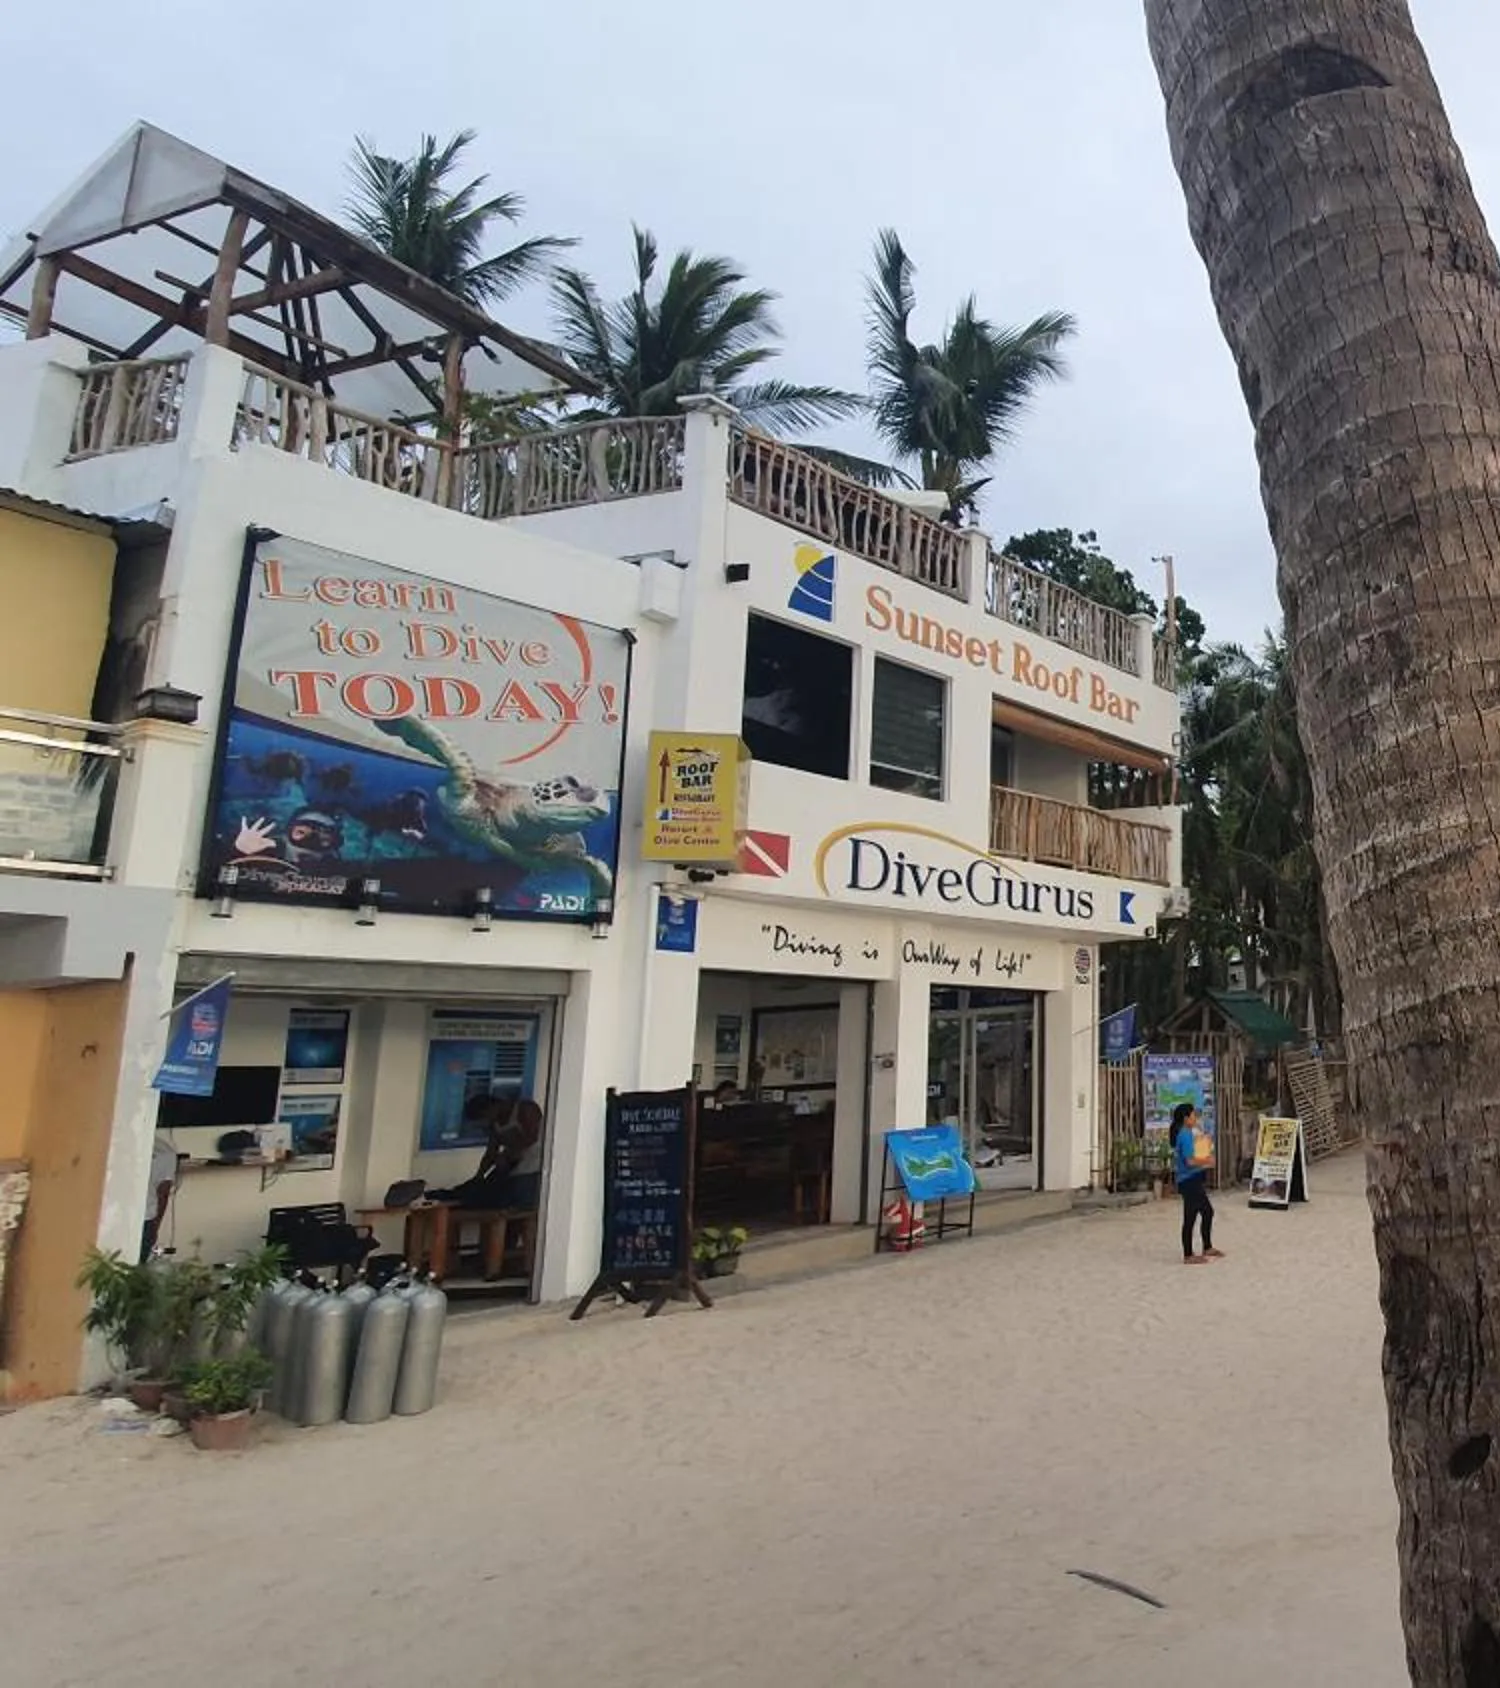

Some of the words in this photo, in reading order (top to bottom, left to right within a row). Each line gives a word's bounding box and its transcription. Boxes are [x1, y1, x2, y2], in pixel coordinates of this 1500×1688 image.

[260, 559, 457, 615] Learn
[311, 618, 382, 657] to
[400, 620, 552, 667] Dive
[865, 584, 1003, 675] Sunset
[1012, 644, 1084, 705] Roof
[1090, 671, 1141, 724] Bar
[269, 669, 619, 724] TODAY!
[680, 775, 712, 789] BAR
[540, 893, 586, 911] PADI
[847, 836, 1094, 921] DiveGurus
[862, 941, 879, 960] is
[970, 946, 983, 977] of
